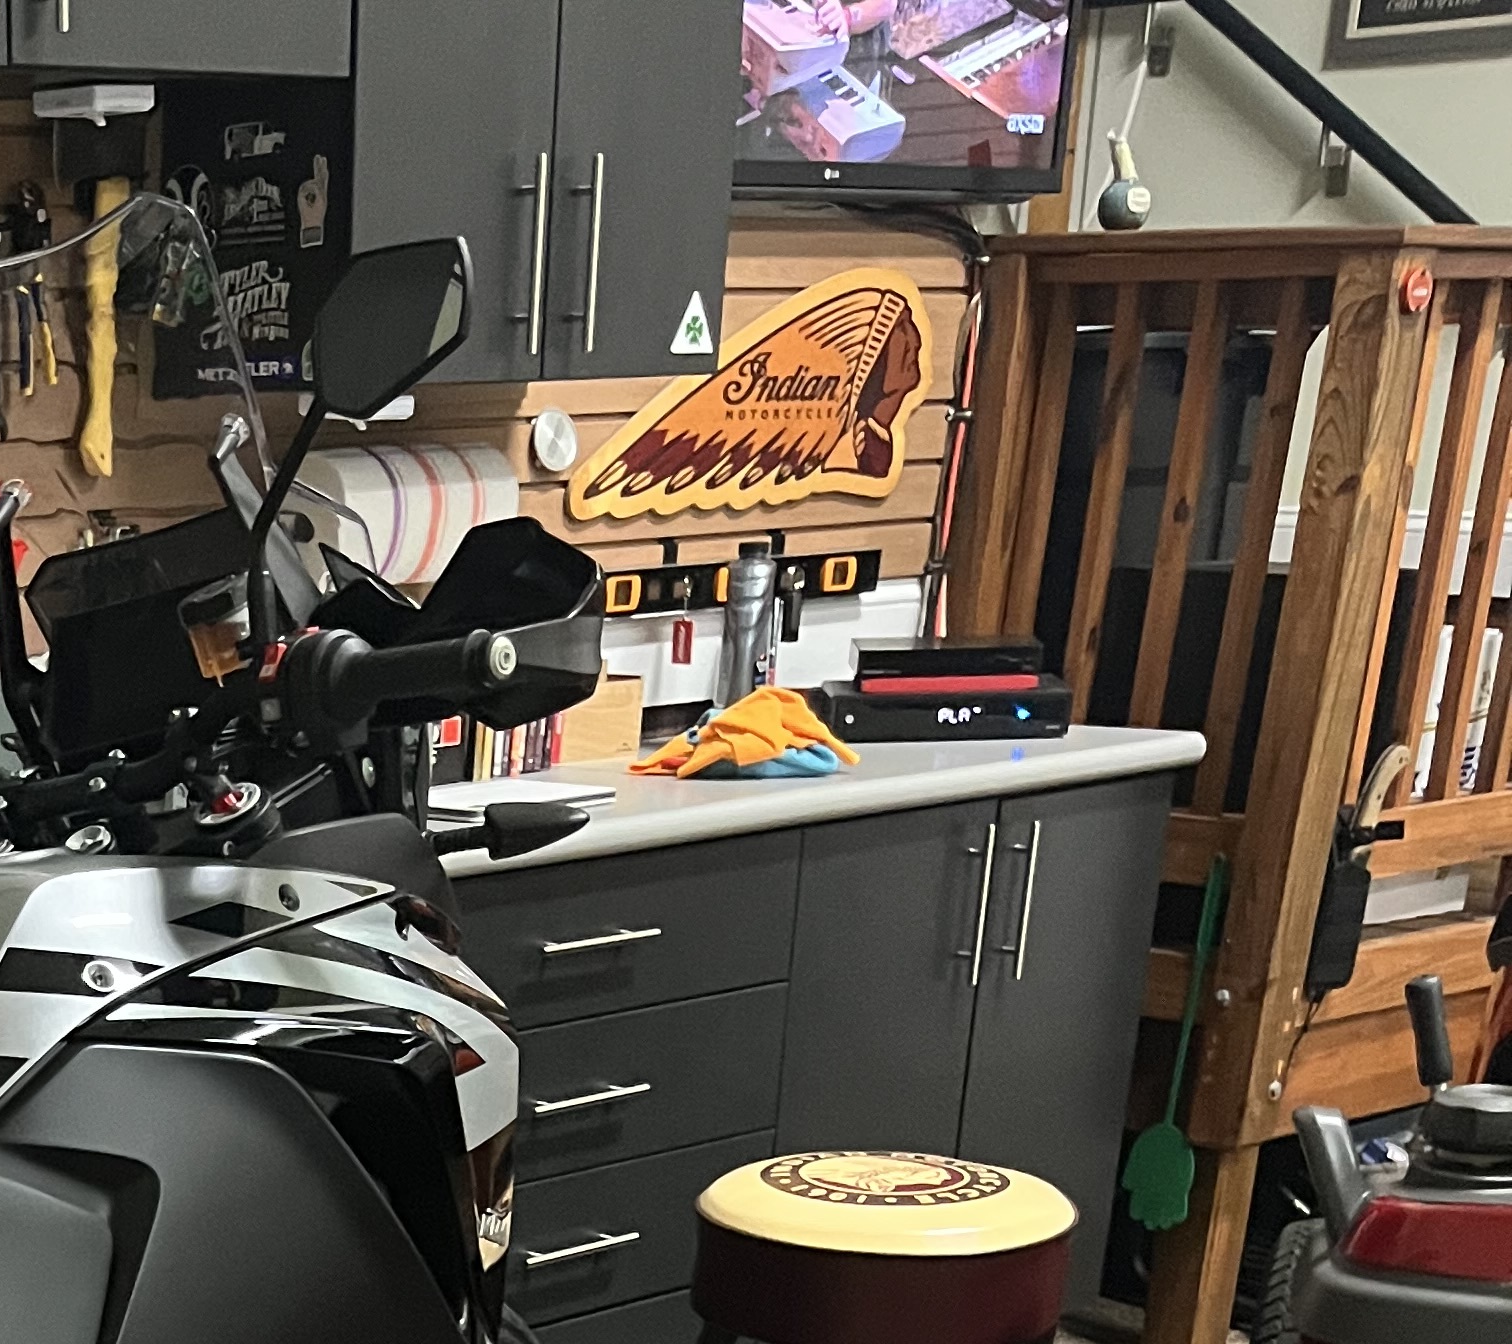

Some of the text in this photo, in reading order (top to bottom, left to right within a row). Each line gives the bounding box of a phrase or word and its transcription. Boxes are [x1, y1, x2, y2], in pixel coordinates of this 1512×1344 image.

[197, 361, 279, 381] METZLER
[723, 351, 840, 405] Indian
[725, 408, 834, 420] MOTORCYCLE
